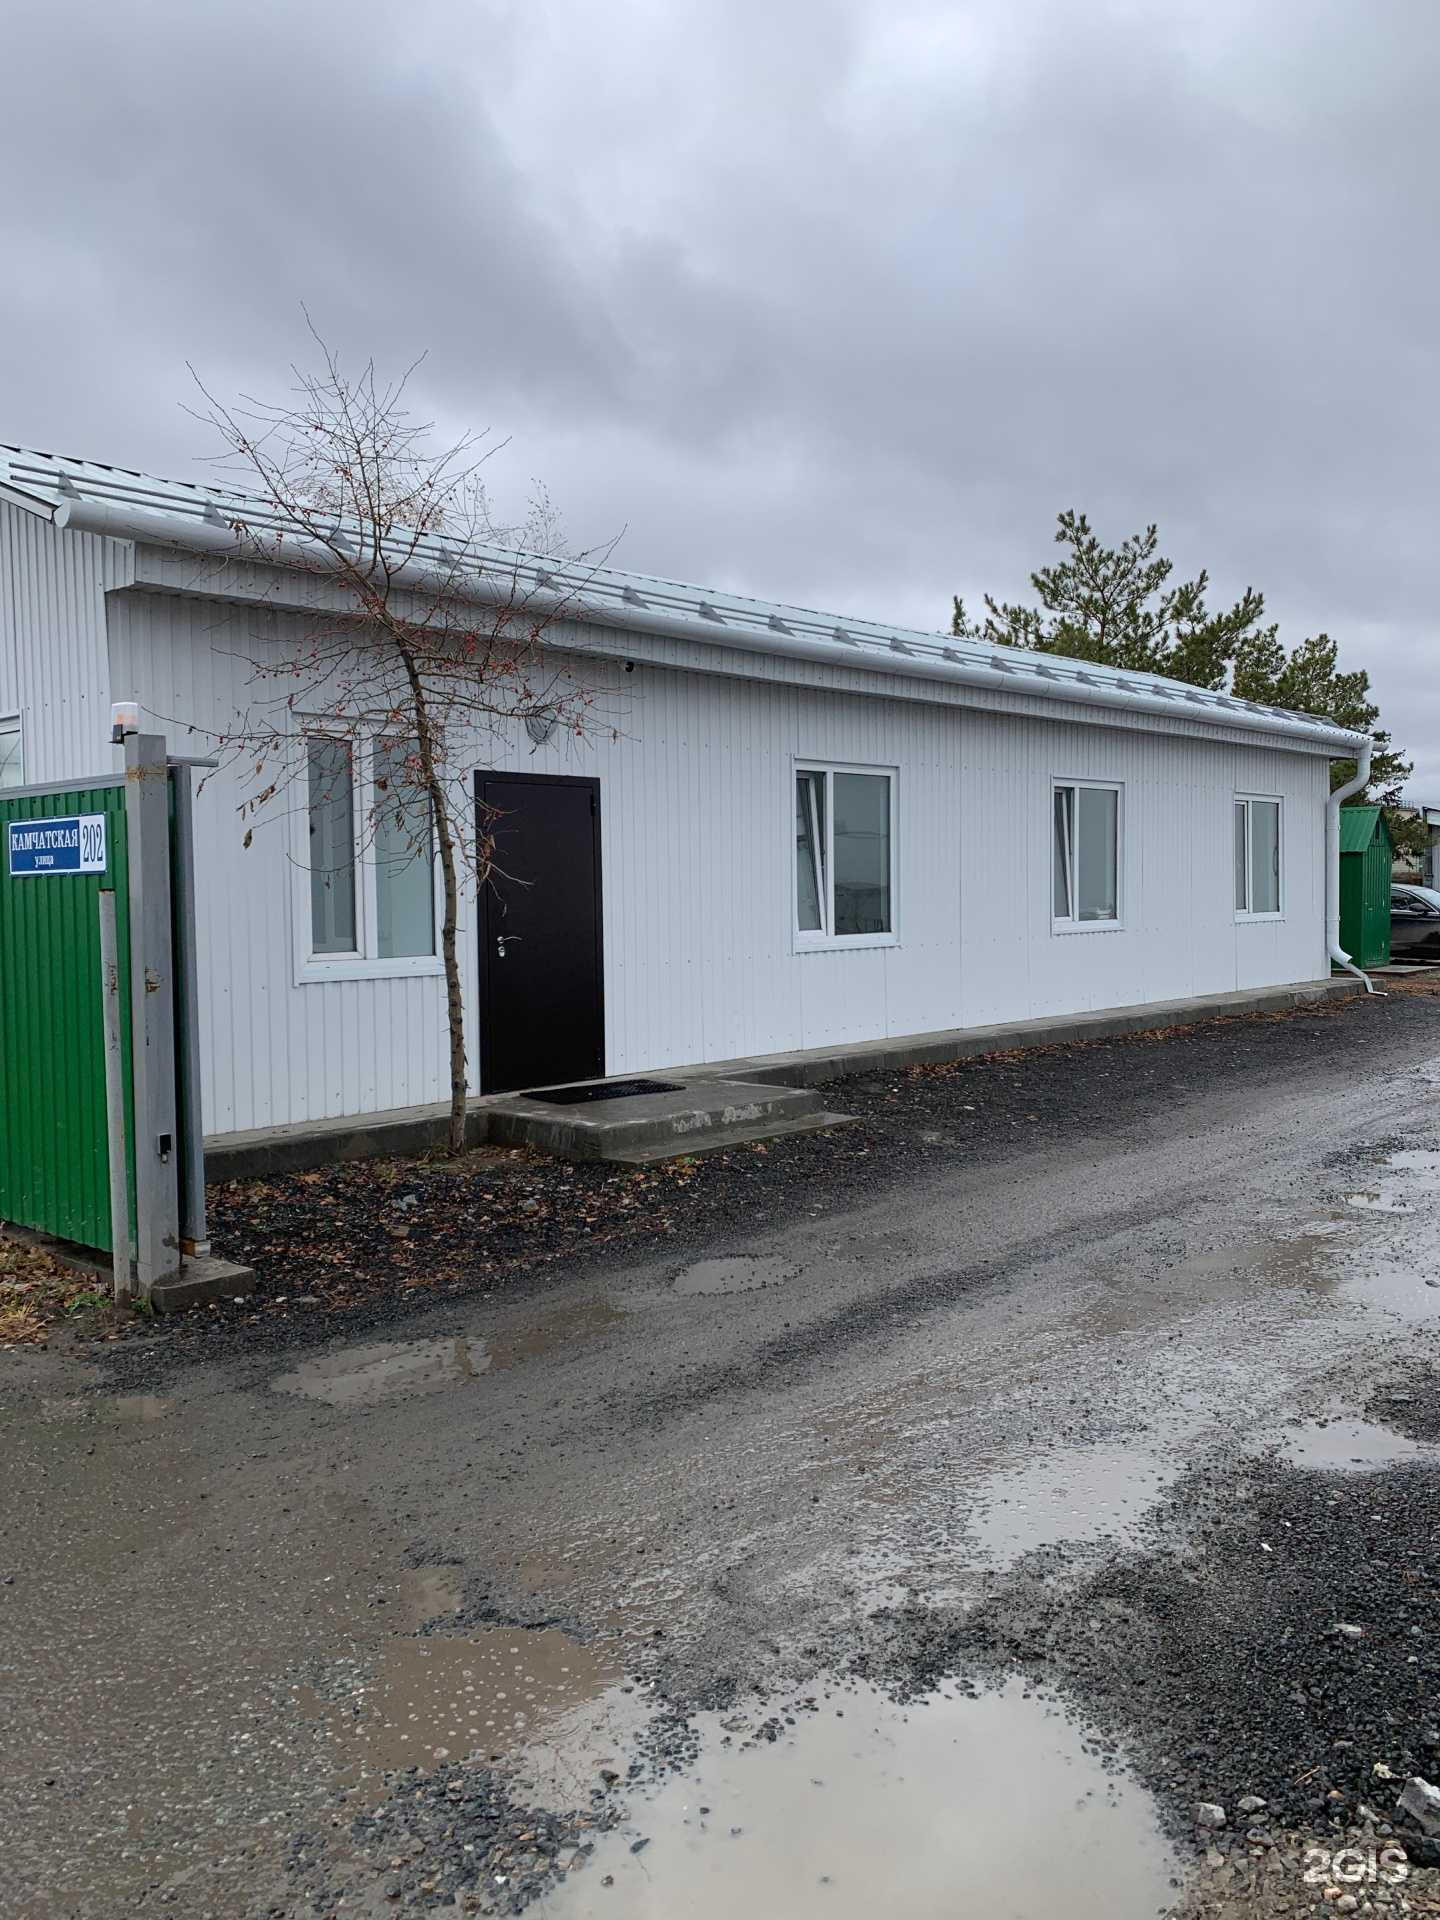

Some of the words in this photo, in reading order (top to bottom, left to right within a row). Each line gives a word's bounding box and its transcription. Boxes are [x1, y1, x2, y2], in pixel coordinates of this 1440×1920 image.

[11, 829, 79, 851] КАМЧАТСКАЯ
[82, 823, 104, 863] 202
[34, 855, 54, 868] улица
